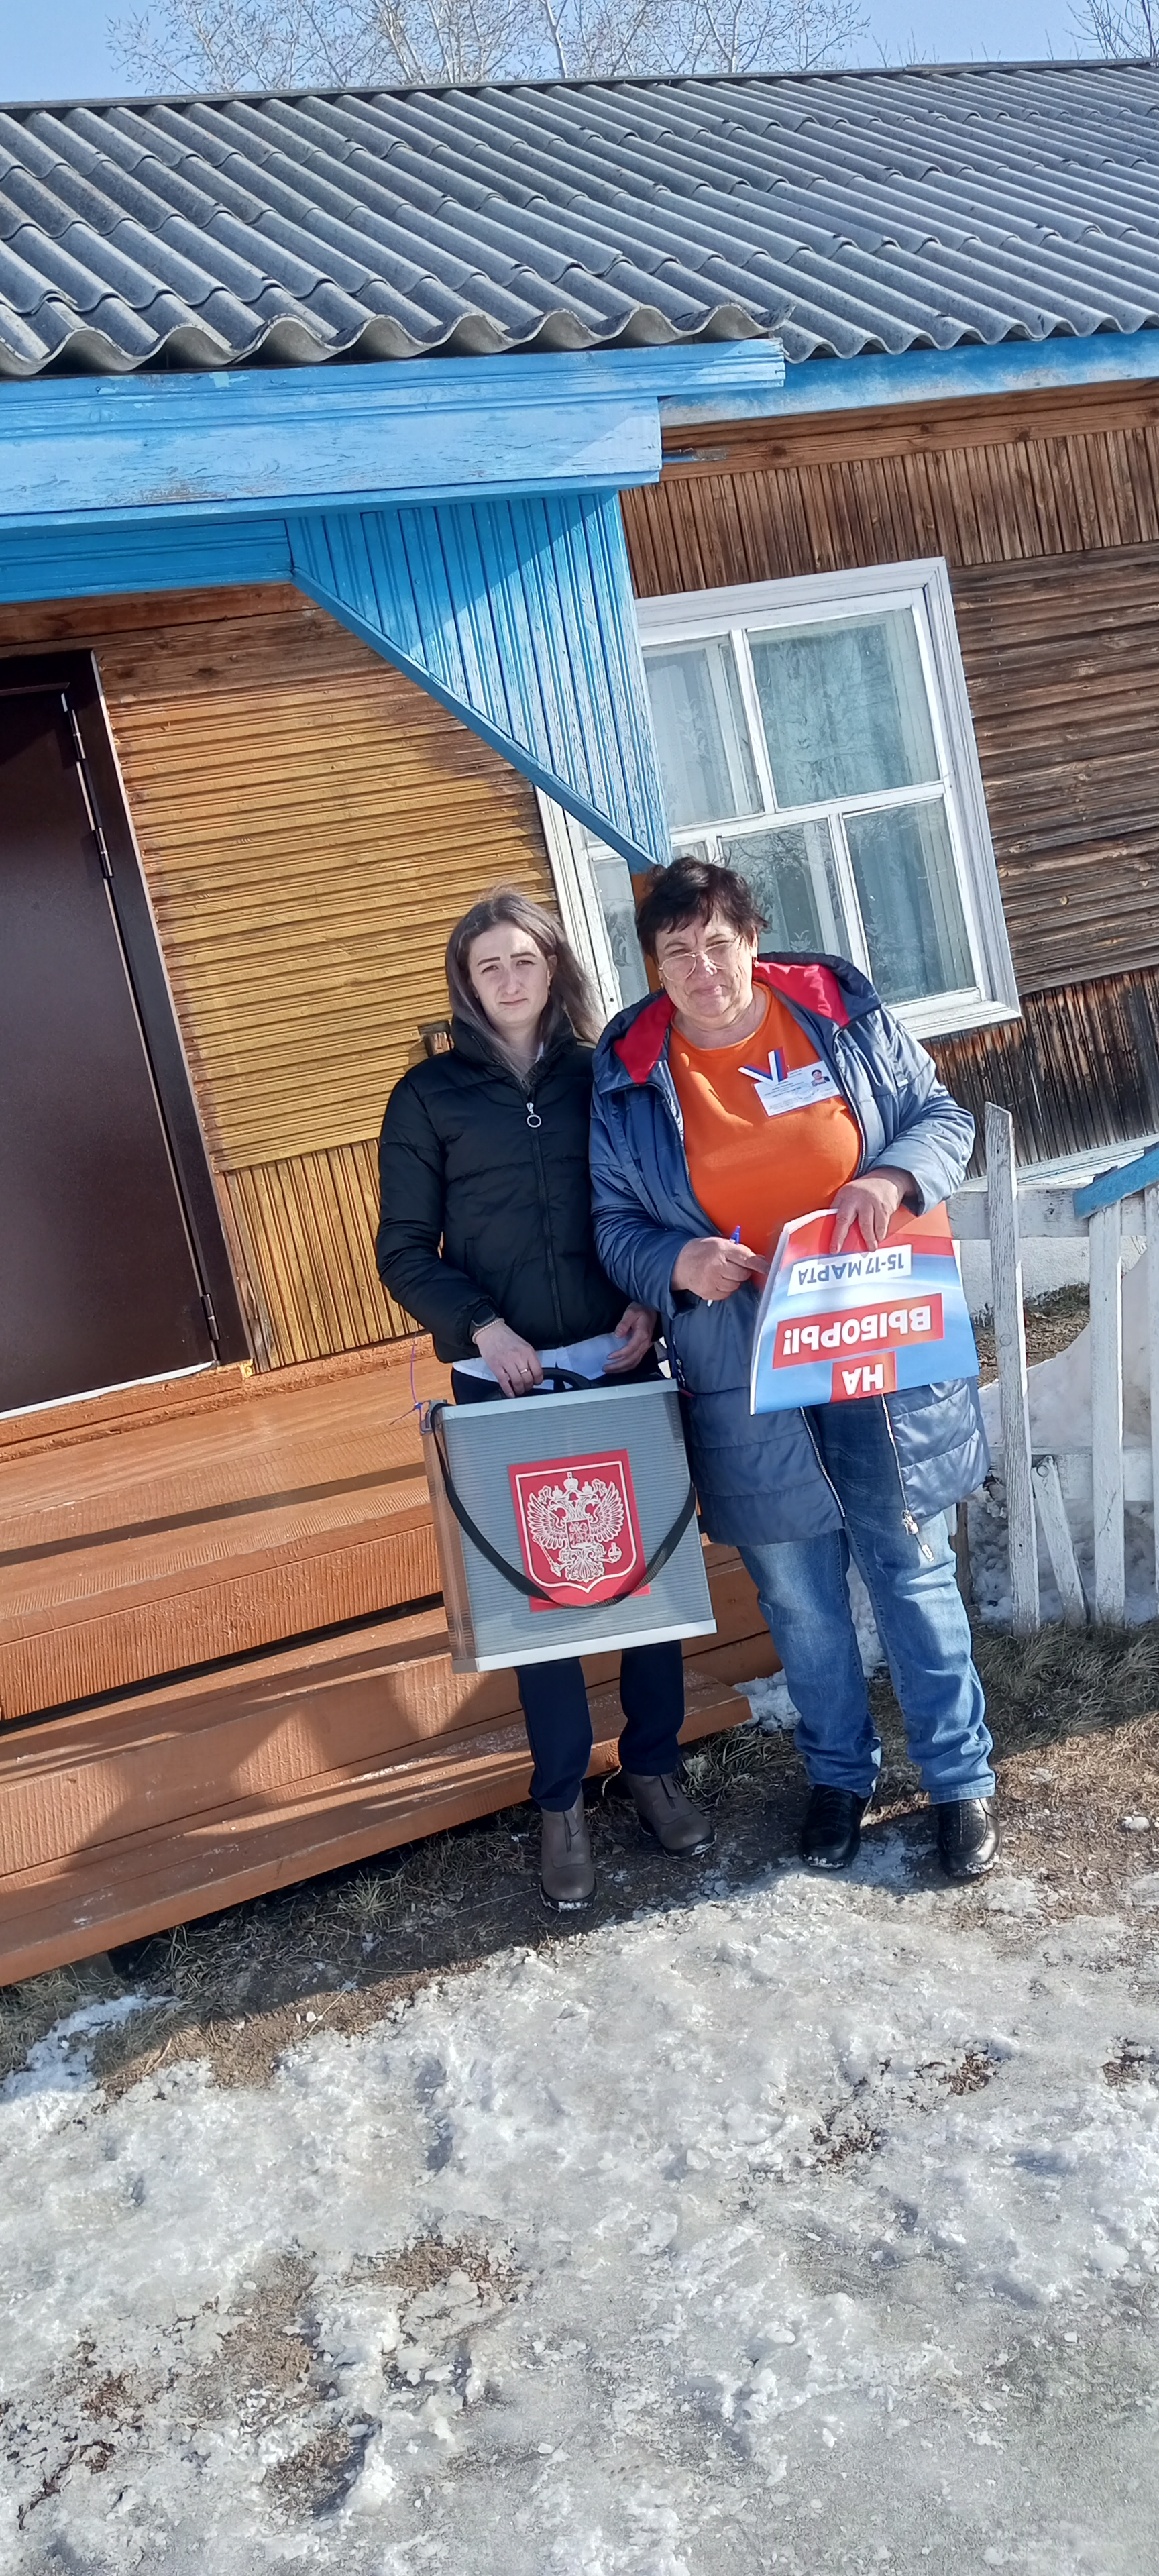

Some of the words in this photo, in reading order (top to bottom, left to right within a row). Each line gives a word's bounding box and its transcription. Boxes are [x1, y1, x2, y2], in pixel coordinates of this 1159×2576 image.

[798, 1260, 862, 1285] МАРТА
[865, 1252, 904, 1275] 15-17
[782, 1305, 932, 1356] ВЫБОРЫ!
[841, 1363, 884, 1395] НА
